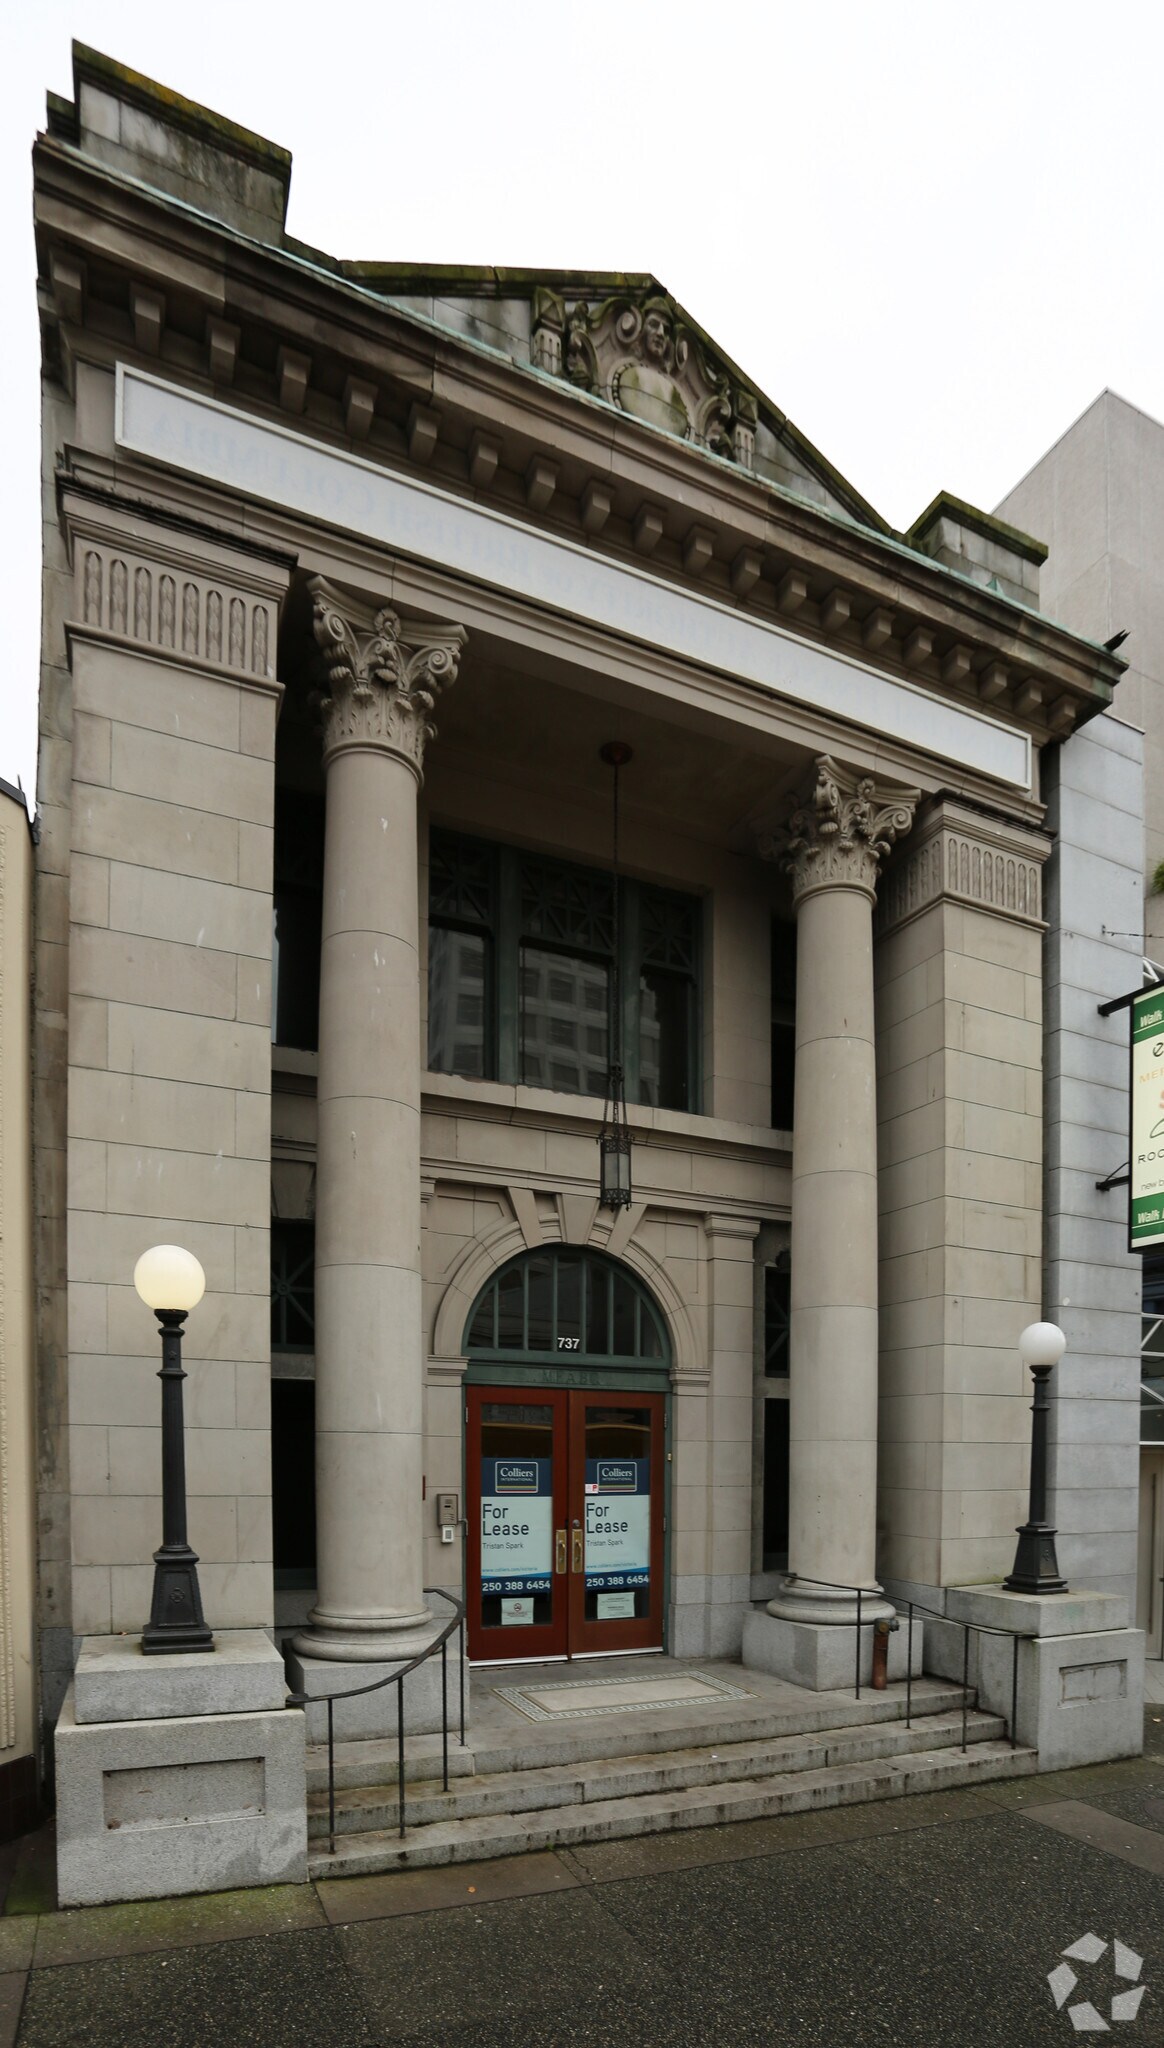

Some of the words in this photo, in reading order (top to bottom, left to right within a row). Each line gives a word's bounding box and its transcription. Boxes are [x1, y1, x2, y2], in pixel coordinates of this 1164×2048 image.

[557, 1337, 580, 1350] 737
[500, 1467, 534, 1477] Colliers
[601, 1467, 633, 1477] Colliers
[482, 1503, 509, 1519] For
[586, 1502, 610, 1518] For
[482, 1520, 530, 1536] Lease
[586, 1519, 629, 1534] Lease
[482, 1542, 504, 1550] Tristan
[506, 1541, 524, 1550] Spark
[607, 1538, 624, 1547] Spark
[482, 1582, 502, 1592] 250
[505, 1581, 524, 1591] 388
[526, 1580, 551, 1590] 6454
[586, 1577, 605, 1587] 250
[607, 1576, 624, 1586] 388
[626, 1574, 649, 1584] 6454
